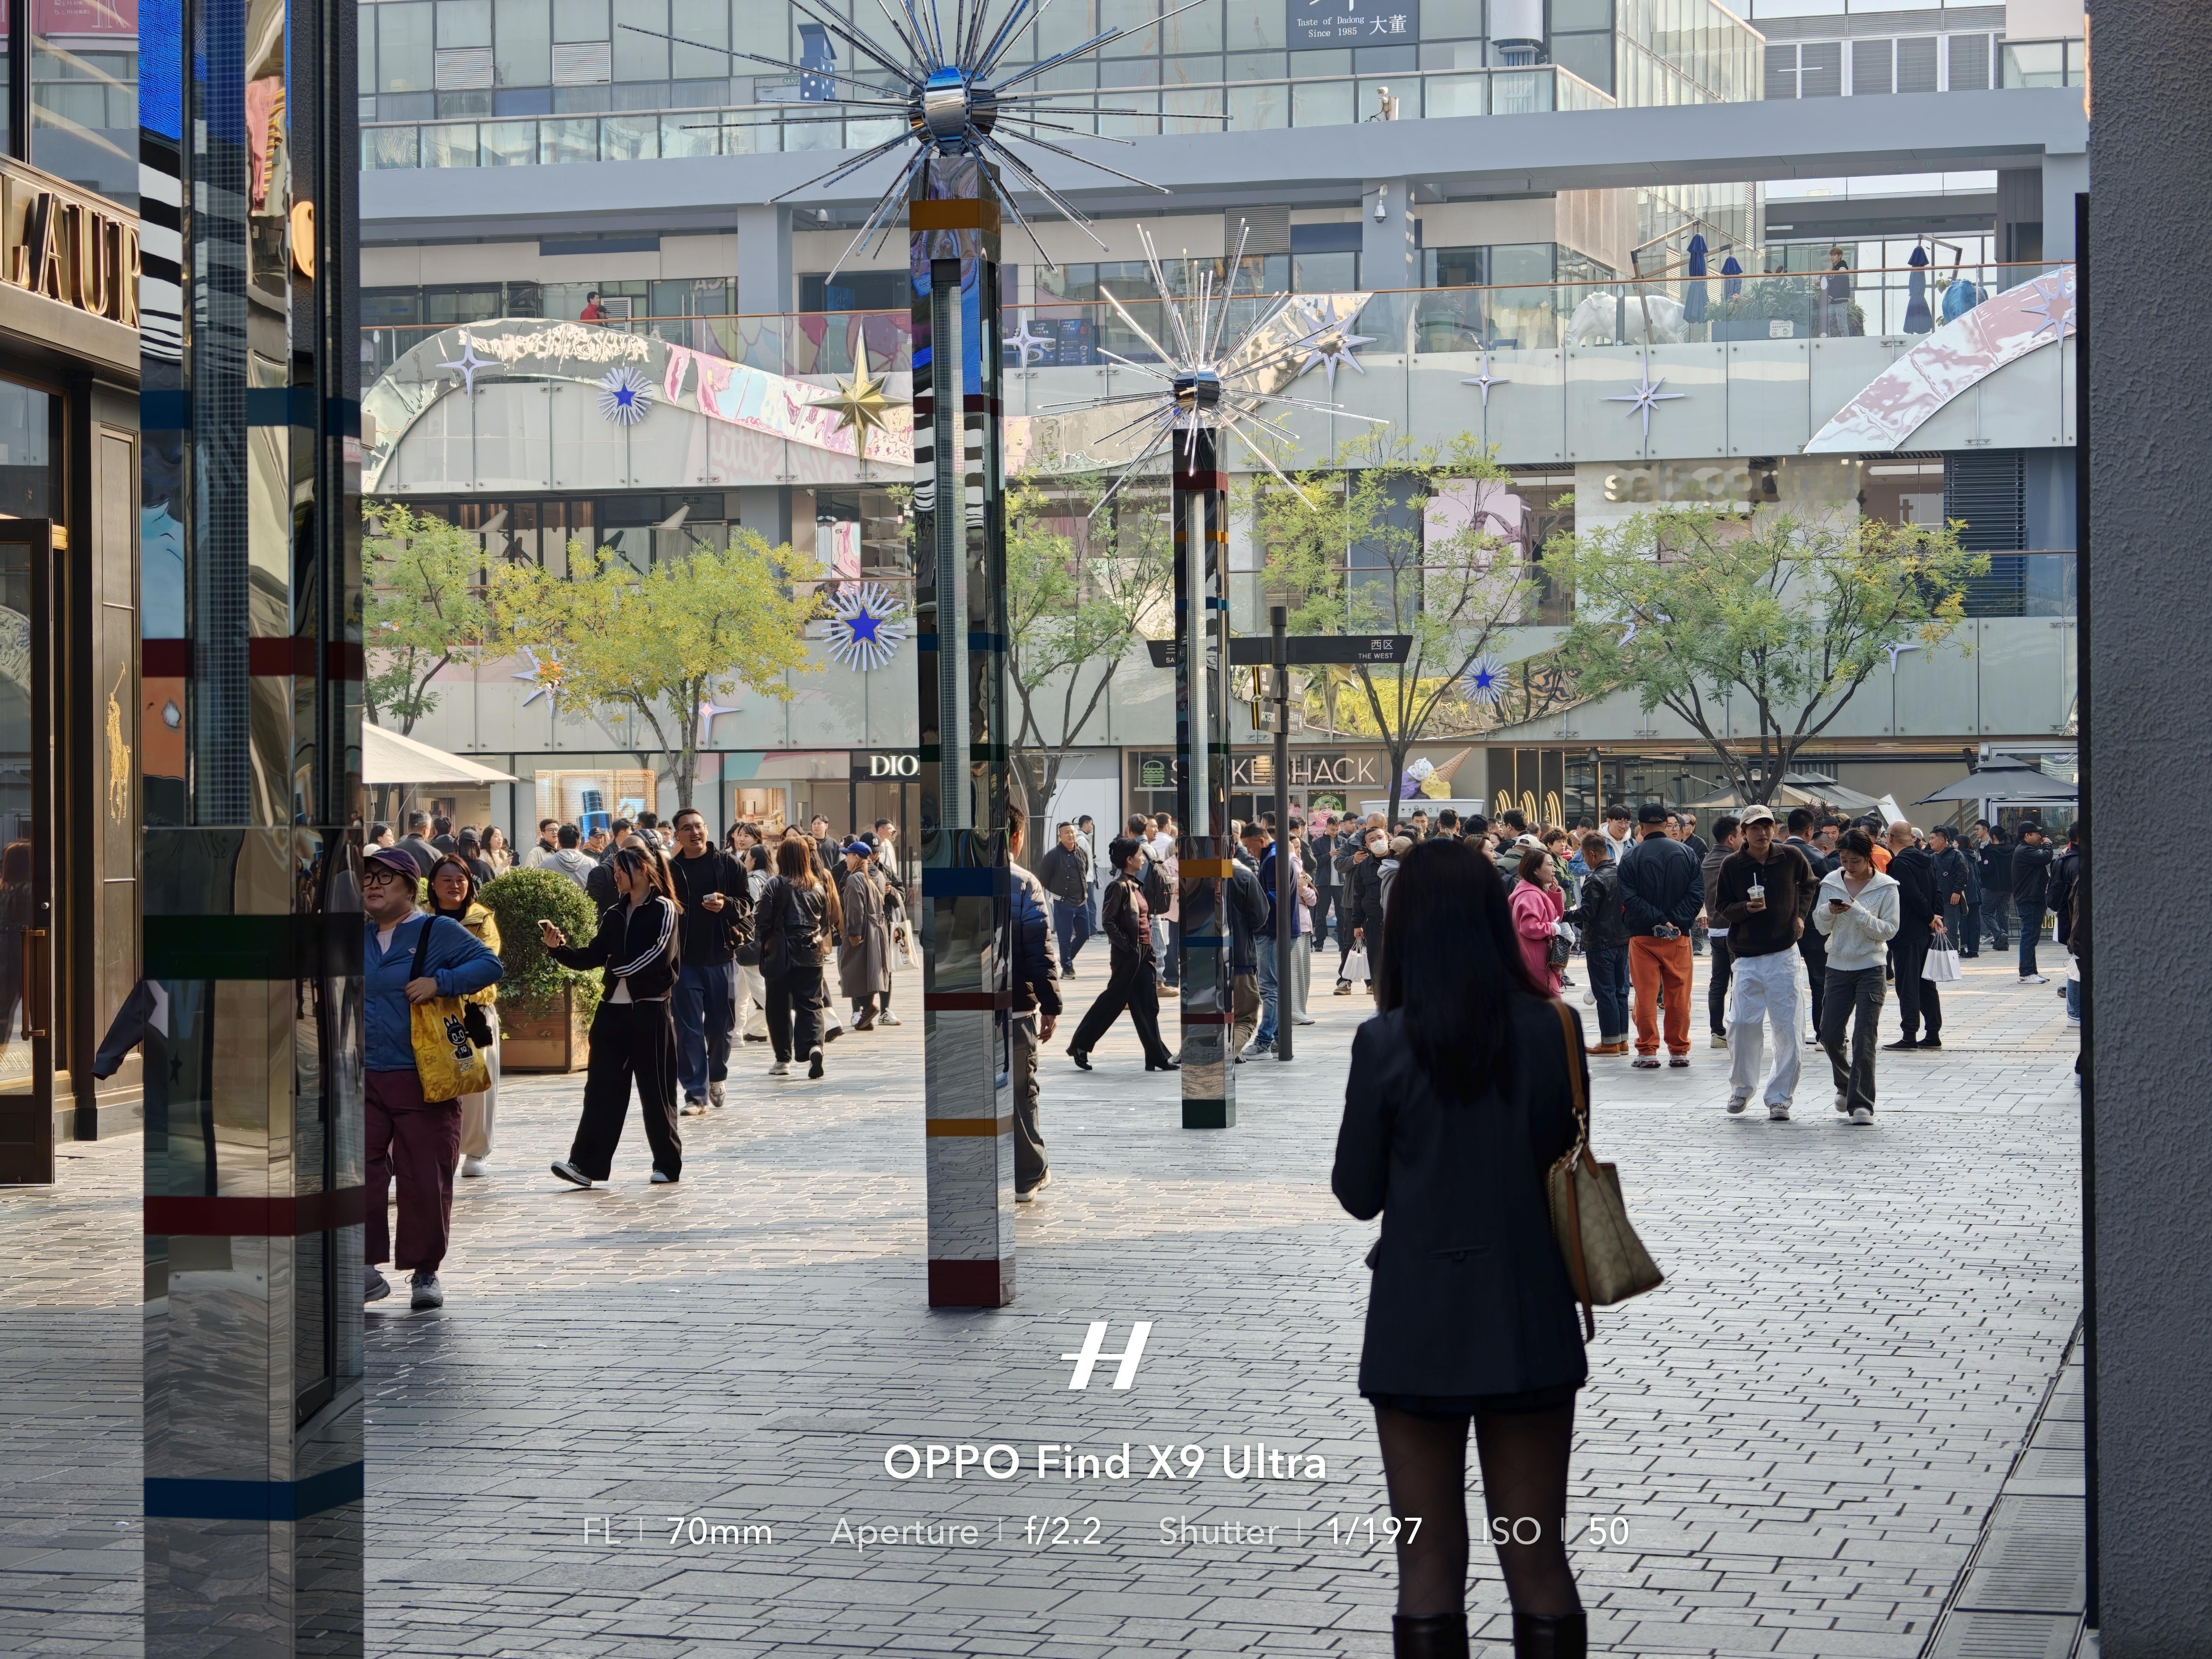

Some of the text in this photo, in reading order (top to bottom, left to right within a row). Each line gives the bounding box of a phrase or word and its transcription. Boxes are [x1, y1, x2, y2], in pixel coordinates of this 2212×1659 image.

[1337, 16, 1364, 25] Dadong
[1369, 14, 1407, 35] 大董
[1338, 27, 1357, 36] 1985
[1371, 639, 1393, 650] 西区
[870, 755, 920, 776] DIO
